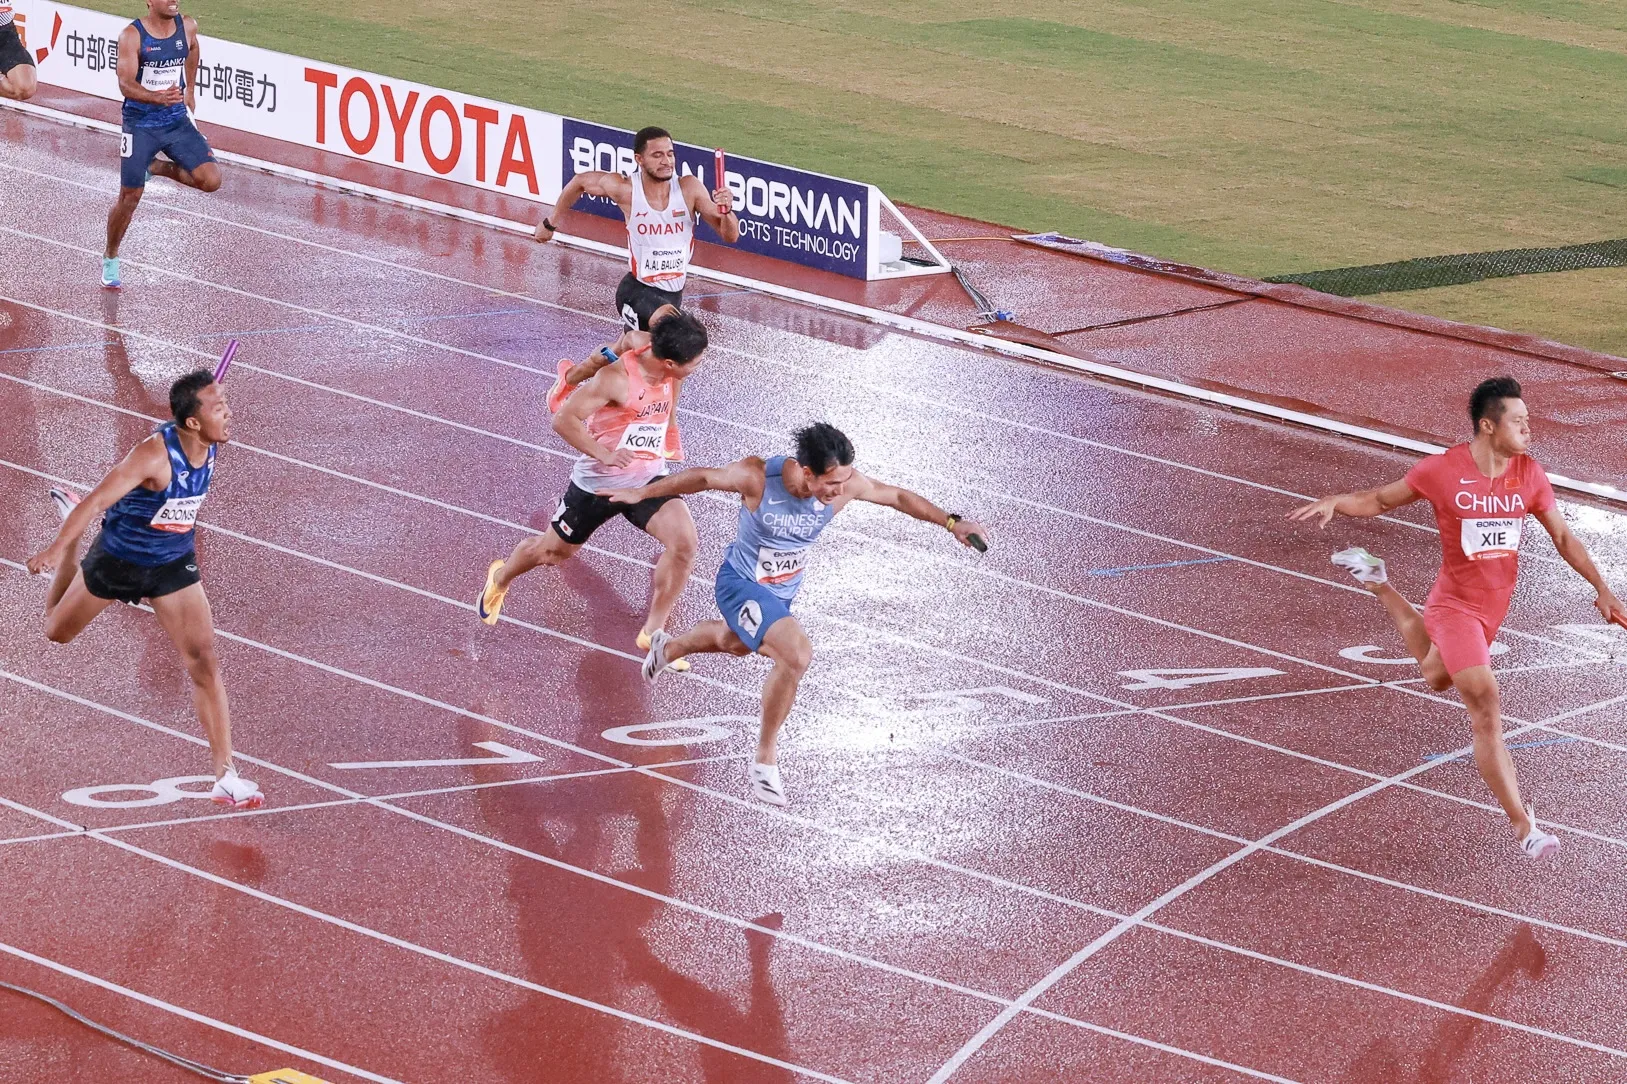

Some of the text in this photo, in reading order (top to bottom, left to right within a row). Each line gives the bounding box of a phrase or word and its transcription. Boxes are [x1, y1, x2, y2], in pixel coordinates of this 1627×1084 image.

[144, 57, 186, 68] SRI LANKA
[195, 59, 277, 113] 中部電力
[304, 67, 540, 196] TOYOTA
[121, 136, 127, 154] 3
[724, 170, 861, 239] BORNAN
[637, 221, 684, 236] OMAN
[738, 218, 860, 263] ORTS TECHNOLOGY
[645, 259, 659, 271] A.AL
[637, 401, 669, 418] JAPAN
[625, 434, 662, 448] KOIKE
[1455, 491, 1525, 514] CHINA
[762, 512, 825, 527] CHINESE
[1476, 520, 1514, 528] BORNAN
[771, 526, 813, 538] TAIPEI
[1481, 532, 1507, 547] XIE
[740, 606, 757, 627] 7
[1116, 666, 1288, 691] 4
[327, 741, 546, 770] 7
[61, 775, 258, 809] 8
